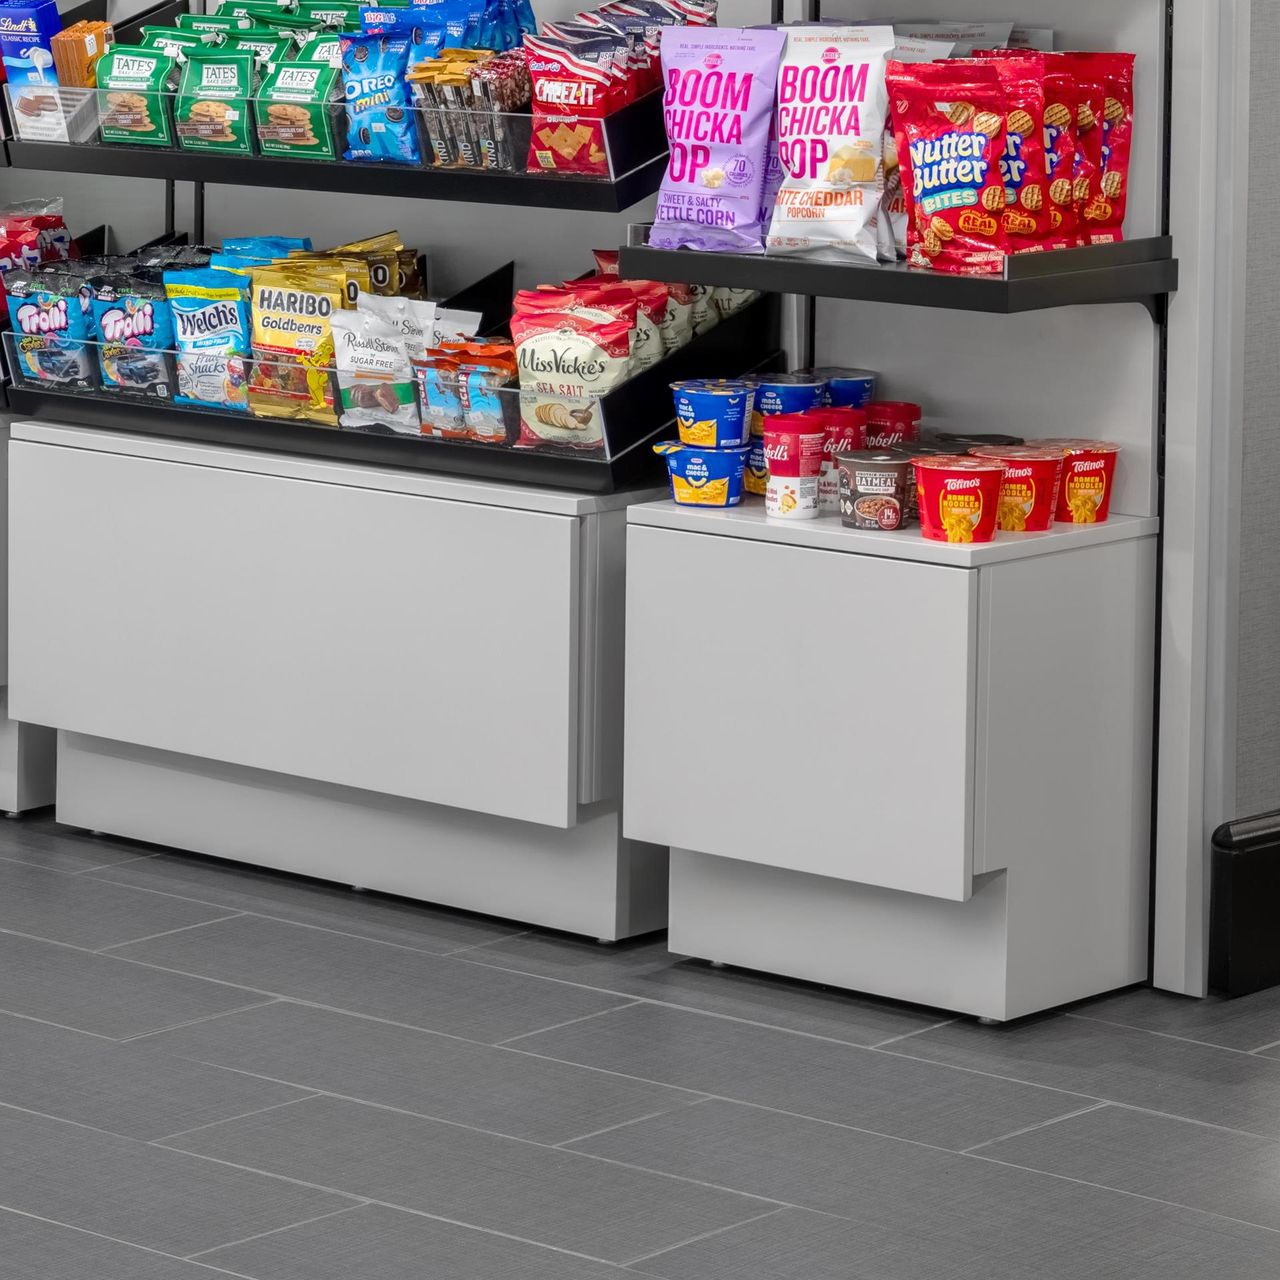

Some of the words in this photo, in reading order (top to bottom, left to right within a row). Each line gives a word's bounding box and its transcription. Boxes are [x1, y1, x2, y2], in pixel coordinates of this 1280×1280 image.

[0, 16, 27, 32] Lindt
[1, 35, 22, 43] CLASSIC
[22, 35, 41, 43] RECIPE
[115, 57, 154, 72] TATE'S
[204, 66, 237, 80] TATE'S
[281, 70, 317, 83] TATE'S
[779, 62, 870, 105] BOOM
[345, 74, 396, 99] OREO
[534, 78, 597, 106] CHEEZ-IT
[664, 67, 754, 112] BOOM
[354, 91, 390, 113] mini
[665, 108, 743, 145] CHICKA
[779, 104, 861, 138] CHICKA
[462, 141, 474, 167] KIND
[486, 139, 498, 169] KIND
[909, 132, 987, 167] Nutter
[733, 159, 746, 173] 70
[912, 159, 988, 196] Butter
[663, 193, 687, 206] SWEET
[687, 194, 694, 206] &
[695, 195, 722, 209] SALTY
[800, 189, 864, 207] CHEDDAR
[923, 188, 977, 212] BITES
[696, 206, 736, 226] CORN
[786, 206, 826, 219] POPCORN
[961, 215, 995, 230] REAL
[259, 288, 332, 317] HARIBO
[16, 299, 68, 334] Trolli
[100, 303, 154, 342] Trolli
[178, 304, 238, 336] Welch's
[261, 315, 323, 336] Goldbears
[342, 331, 373, 353] Russell
[189, 360, 227, 375] Snacks
[350, 355, 370, 367] SUGAR
[371, 357, 394, 369] FREE
[536, 382, 555, 395] SEA
[558, 384, 584, 398] SALT
[760, 403, 783, 411] cheese
[685, 469, 709, 477] cheese
[1071, 458, 1106, 473] Totino's
[855, 476, 897, 488] OATMEAL
[944, 476, 981, 491] Totino's
[1069, 481, 1104, 489] NOODLES
[943, 500, 980, 508] NOODLES
[946, 494, 976, 502] RAMEN
